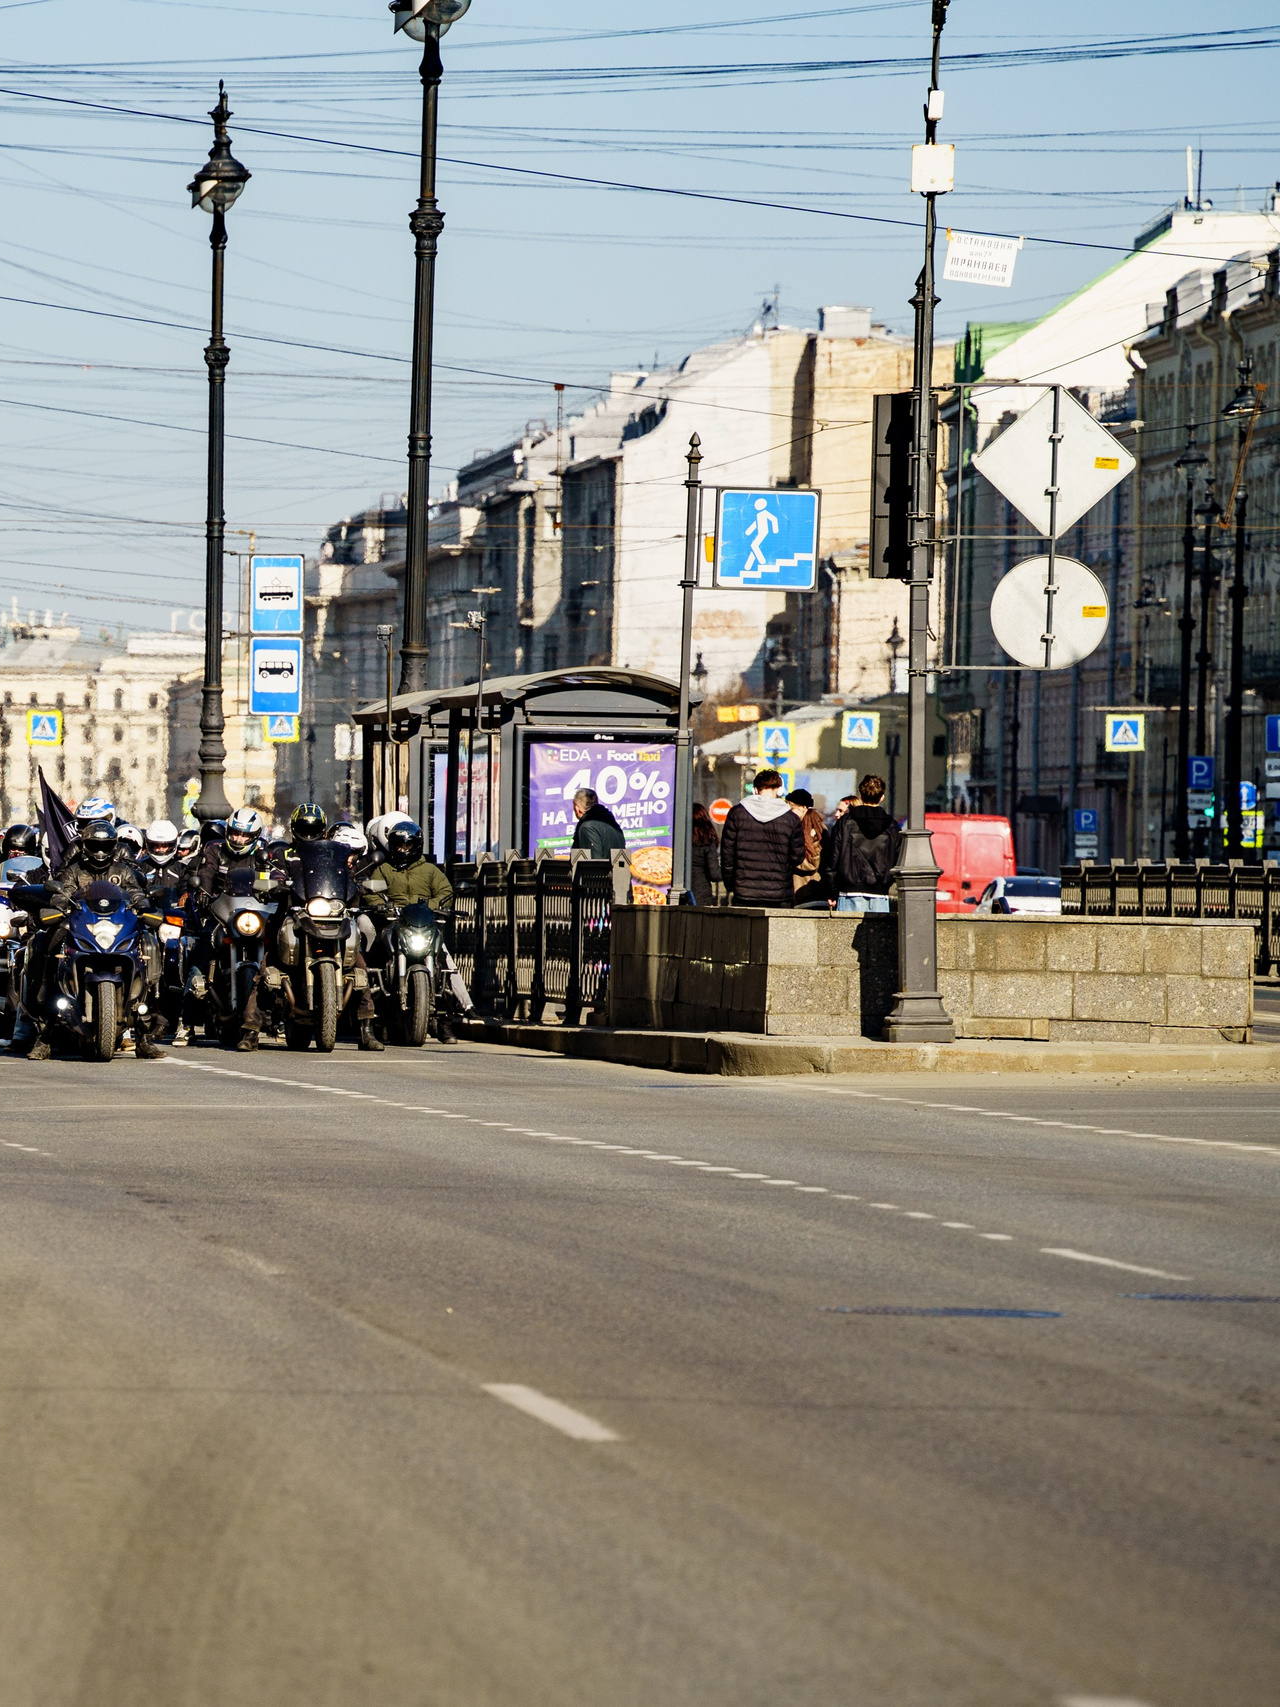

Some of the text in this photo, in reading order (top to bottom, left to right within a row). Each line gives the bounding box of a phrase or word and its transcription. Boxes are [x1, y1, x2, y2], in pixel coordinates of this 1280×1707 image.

[956, 235, 1013, 251] ОСТАНОВКА
[560, 749, 591, 762] EDA
[607, 749, 661, 762] FoodTaxi
[545, 766, 671, 804] -40%
[541, 810, 568, 826] НА
[612, 800, 668, 818] МЕНЮ
